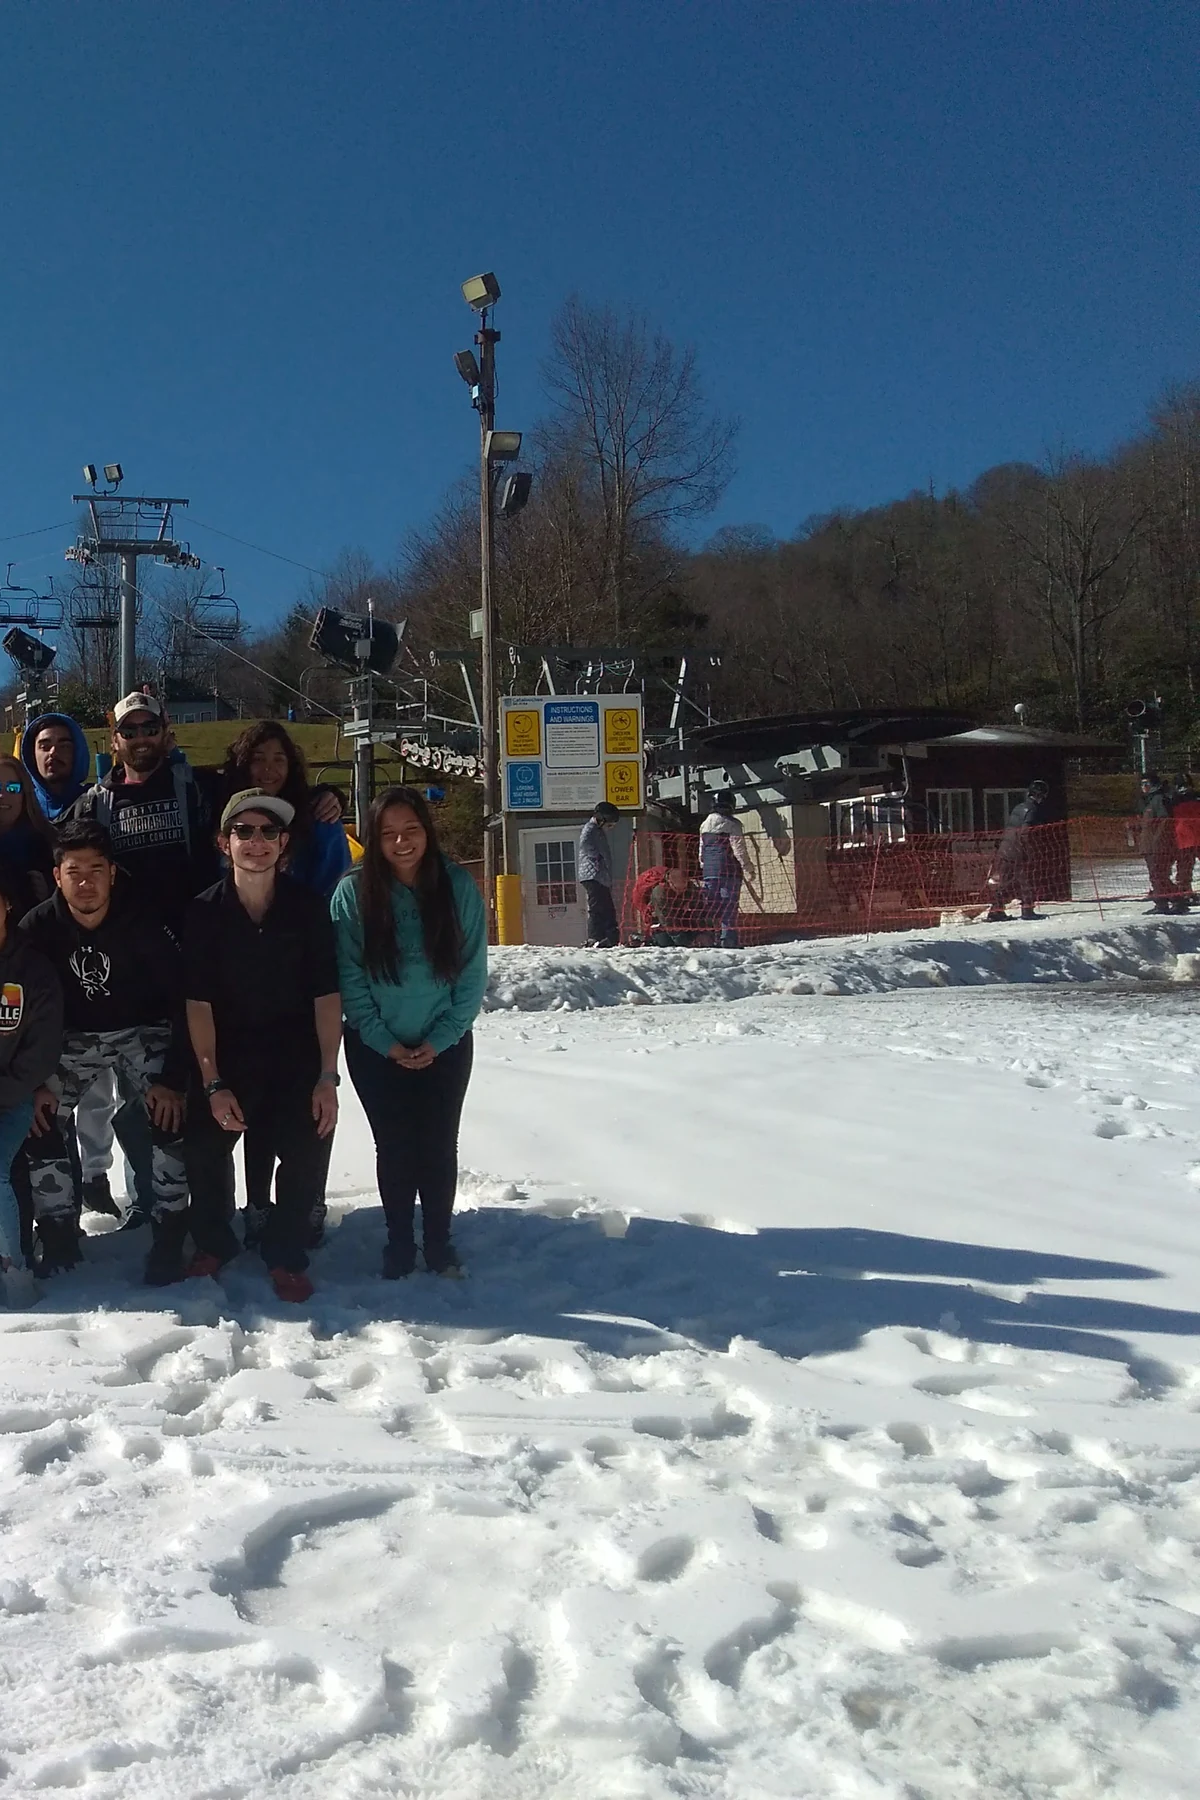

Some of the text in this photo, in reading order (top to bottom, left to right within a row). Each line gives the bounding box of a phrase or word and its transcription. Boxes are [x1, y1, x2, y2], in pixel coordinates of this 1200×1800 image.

[550, 705, 593, 714] INSTRUCTIONS
[563, 715, 595, 723] WARNINGS
[610, 786, 635, 794] LOWER
[149, 829, 183, 843] CONTENT
